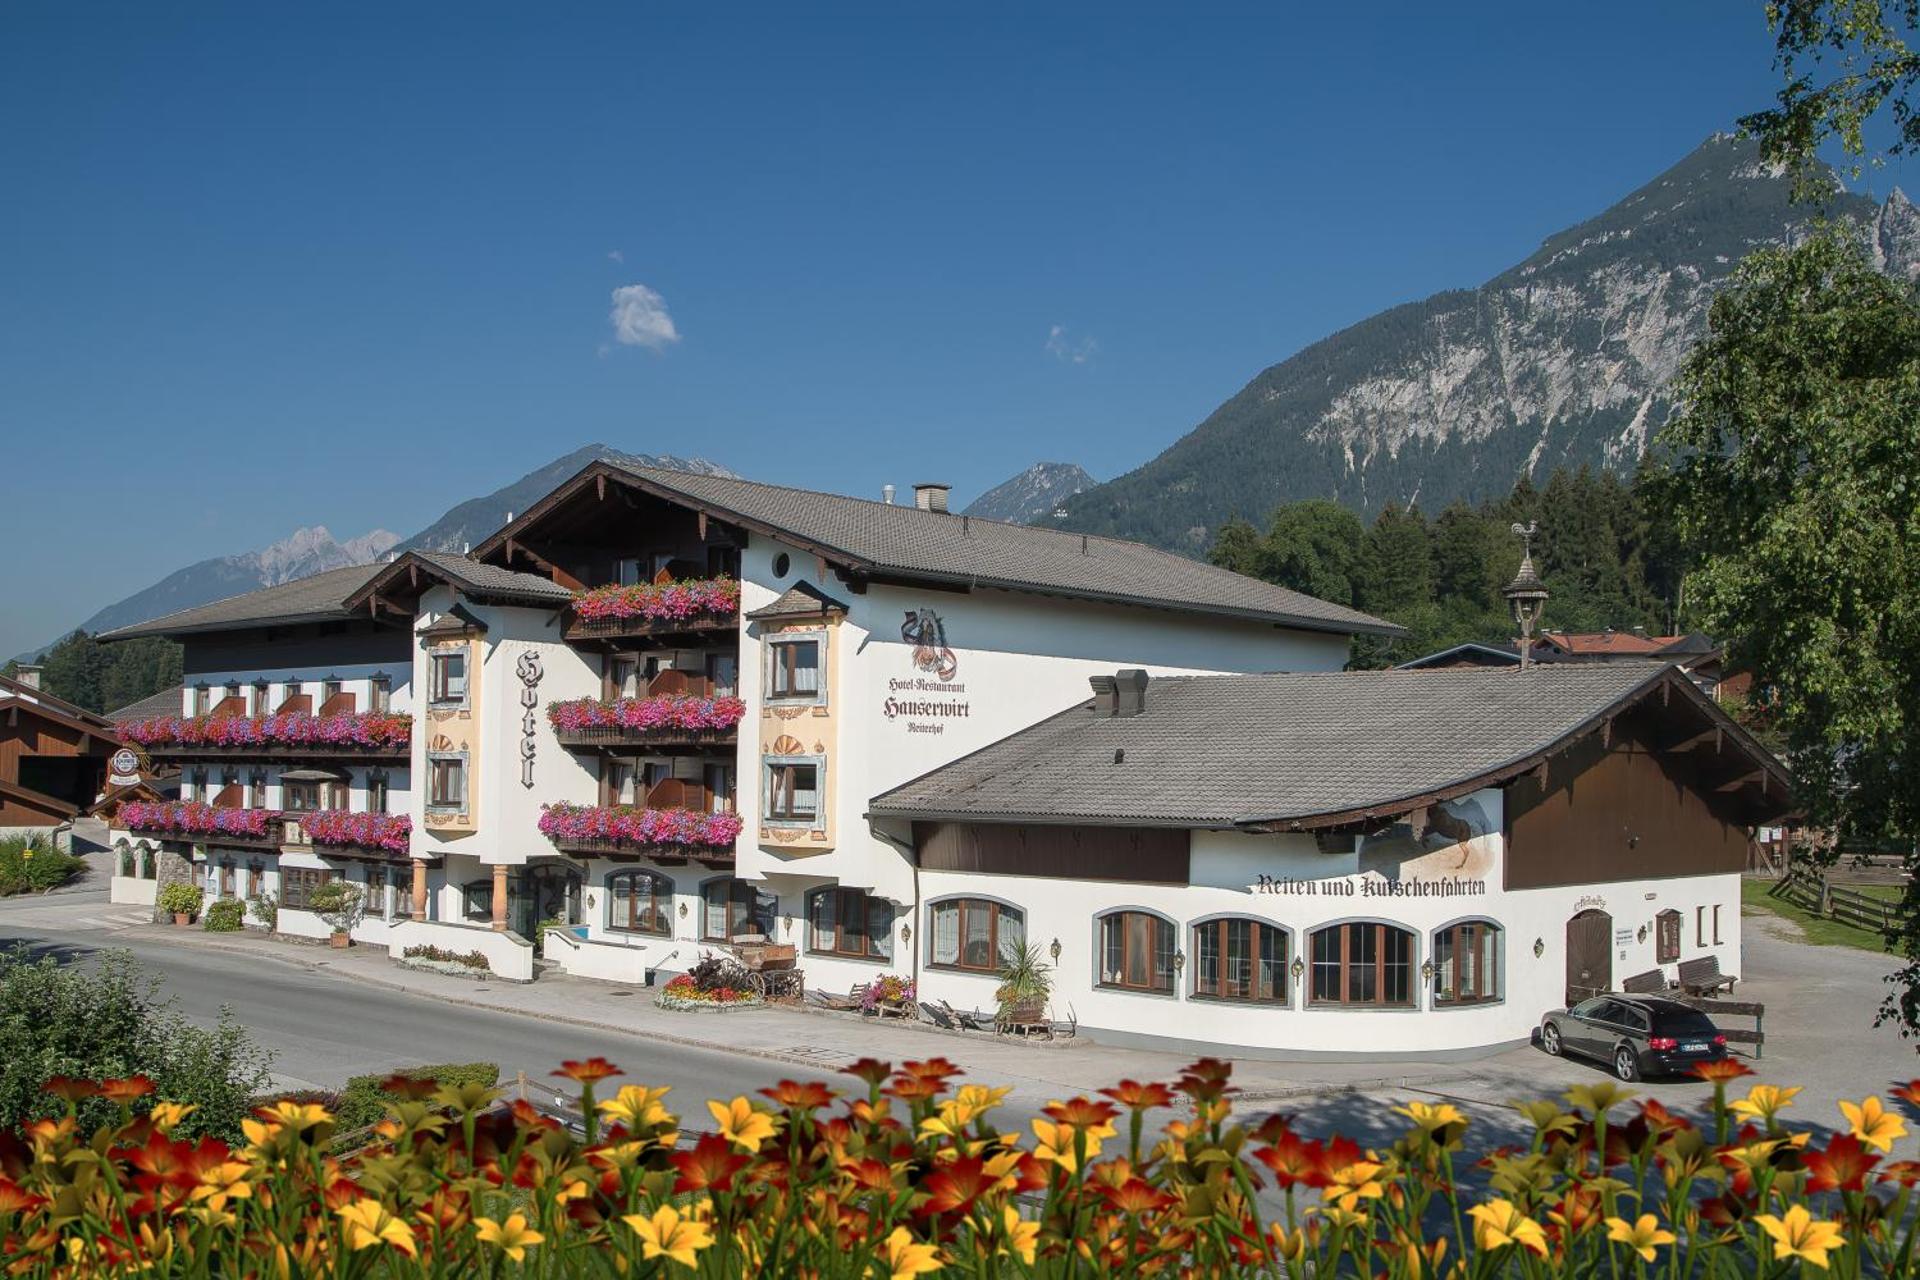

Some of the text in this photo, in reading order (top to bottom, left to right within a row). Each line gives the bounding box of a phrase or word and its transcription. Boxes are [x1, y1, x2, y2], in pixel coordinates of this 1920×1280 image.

[516, 650, 544, 790] Hotel
[884, 696, 969, 721] Hauserwirt
[1258, 874, 1485, 898] Reiten und Kutschenfahrten
